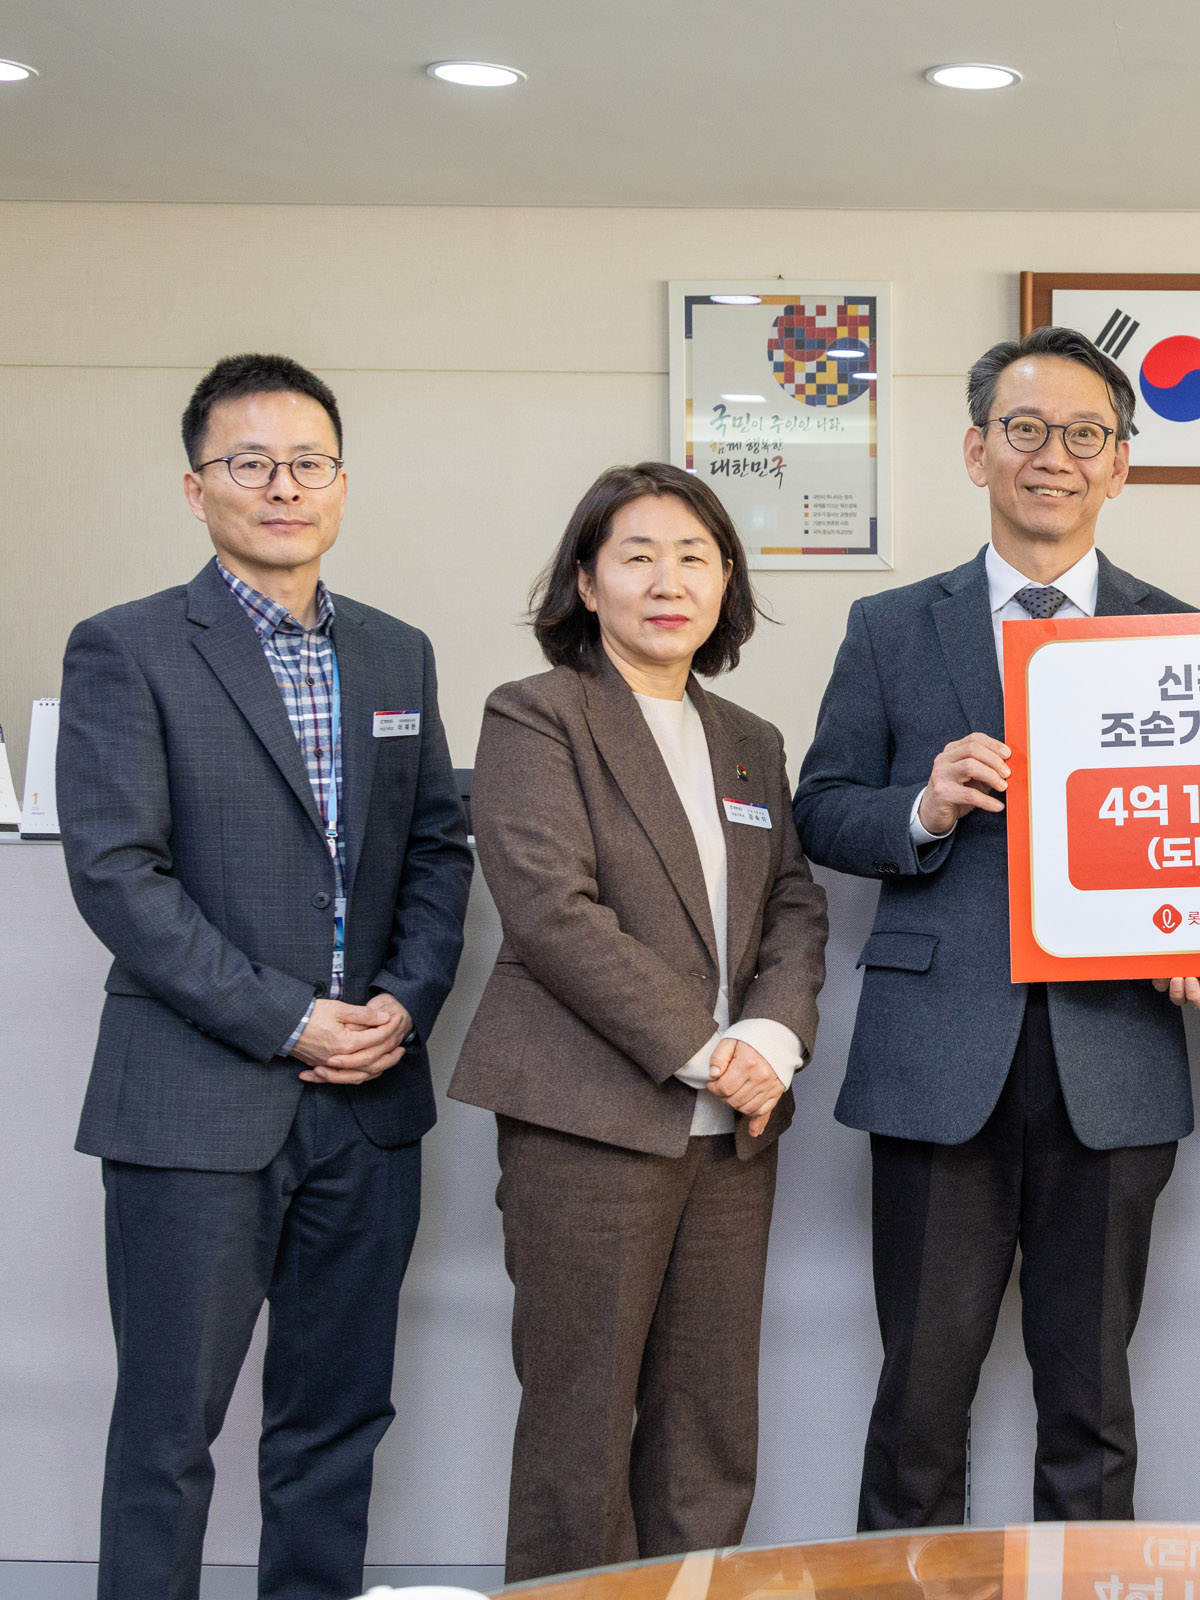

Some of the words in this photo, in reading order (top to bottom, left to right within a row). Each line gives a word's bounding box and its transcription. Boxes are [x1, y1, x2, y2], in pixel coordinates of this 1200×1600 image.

[710, 404, 763, 438] 국민이
[770, 415, 810, 434] 주인인
[746, 438, 783, 454] 행복한
[710, 456, 787, 490] 대한민국
[32, 792, 38, 805] 1
[1098, 784, 1168, 826] 4억
